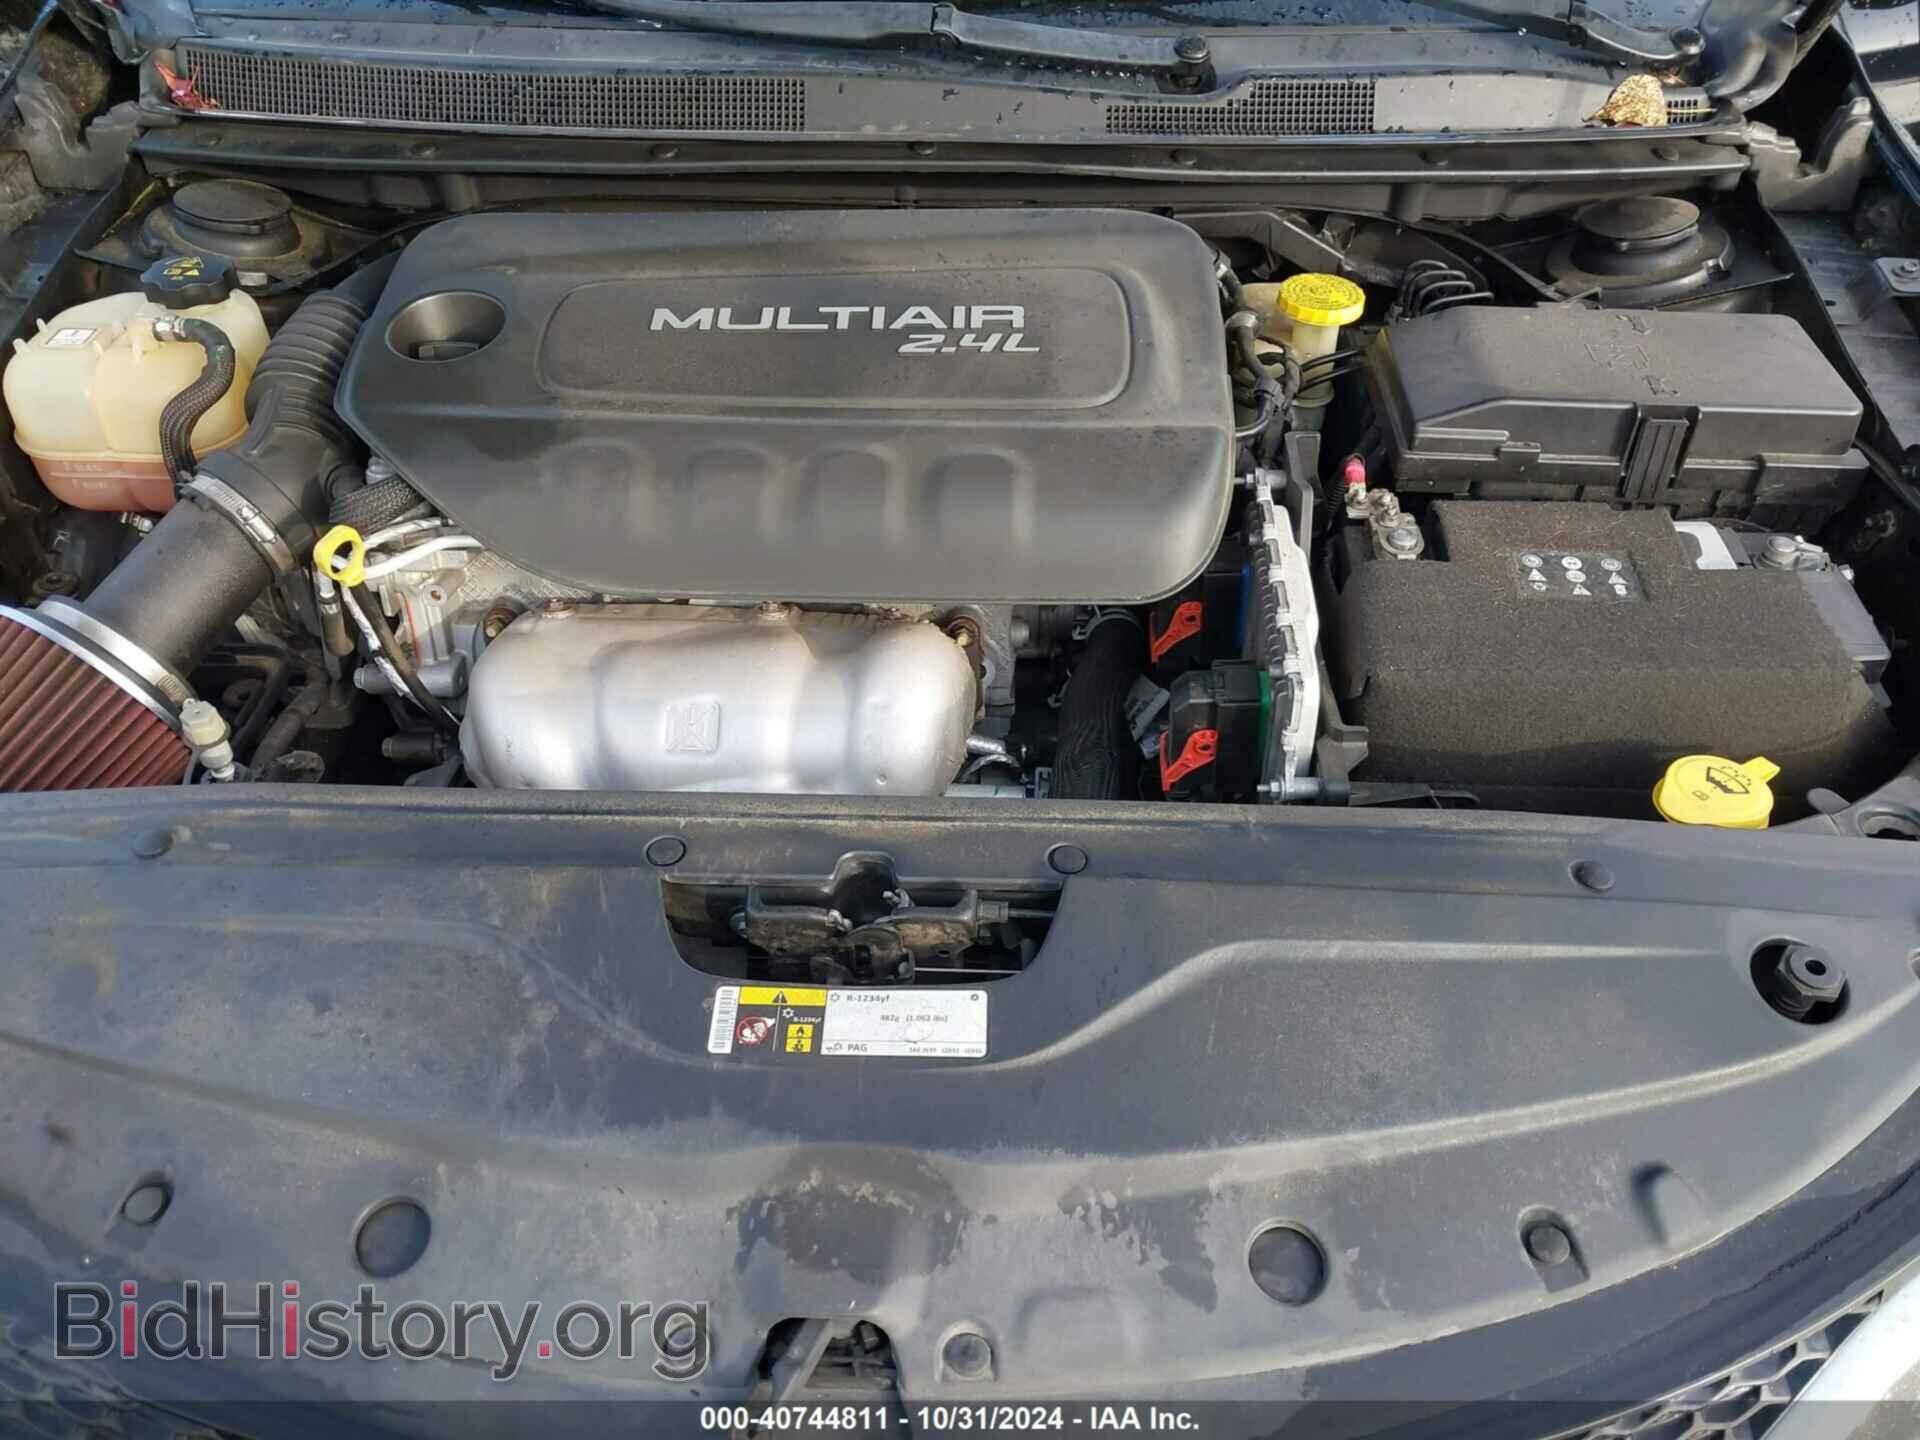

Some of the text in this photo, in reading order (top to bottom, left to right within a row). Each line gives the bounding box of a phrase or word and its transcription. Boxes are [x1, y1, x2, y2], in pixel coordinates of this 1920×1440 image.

[650, 305, 1026, 331] MULTIAIR
[898, 333, 1041, 354] 2.4L
[847, 1043, 868, 1053] PAG
